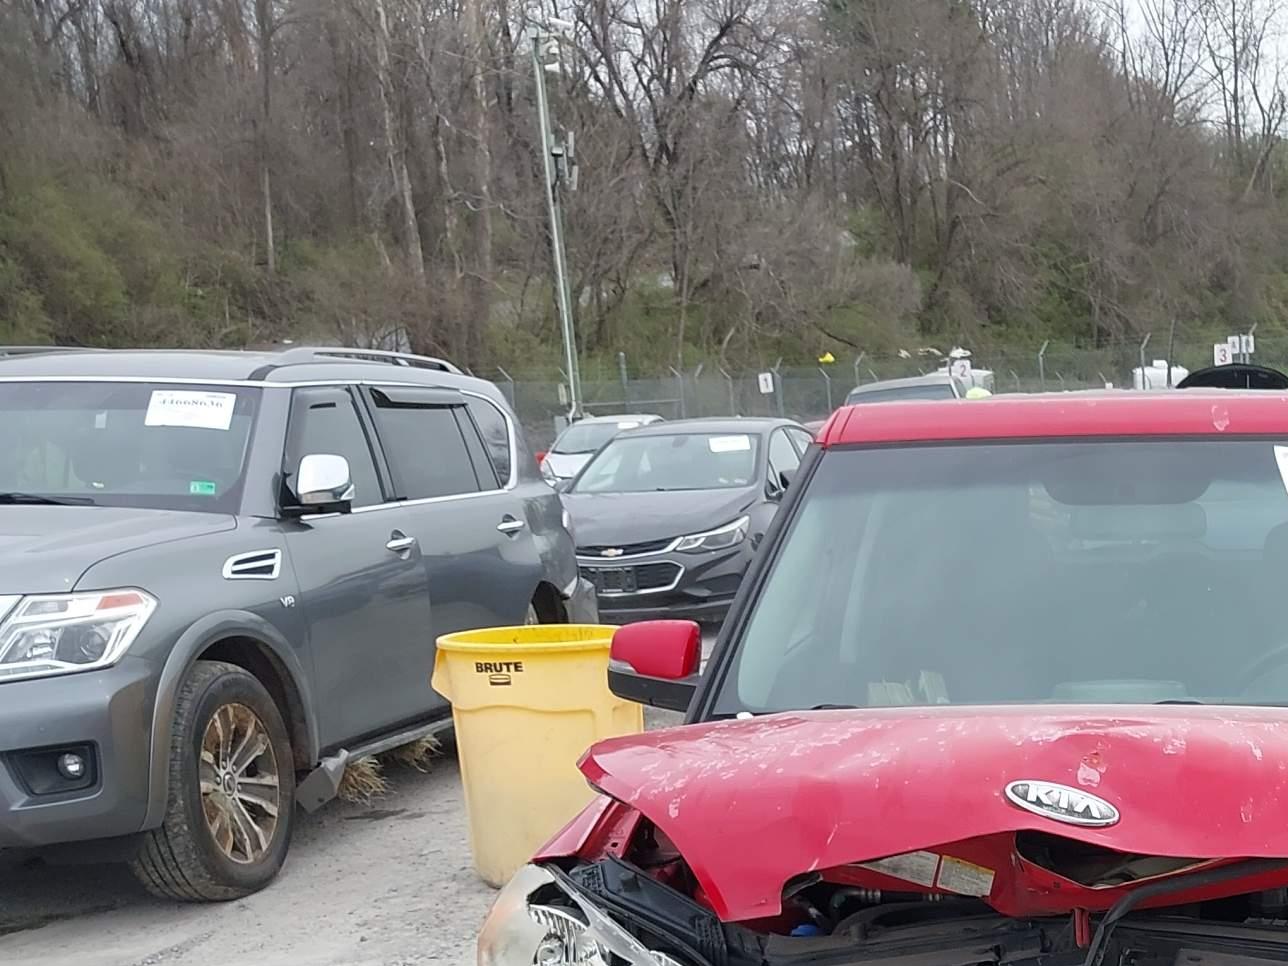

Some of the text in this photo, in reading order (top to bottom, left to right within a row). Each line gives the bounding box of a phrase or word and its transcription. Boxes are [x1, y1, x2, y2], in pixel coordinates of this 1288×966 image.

[1219, 348, 1228, 363] 3
[959, 363, 968, 378] 2
[475, 661, 524, 673] BRUTE
[1026, 784, 1101, 819] KIA
